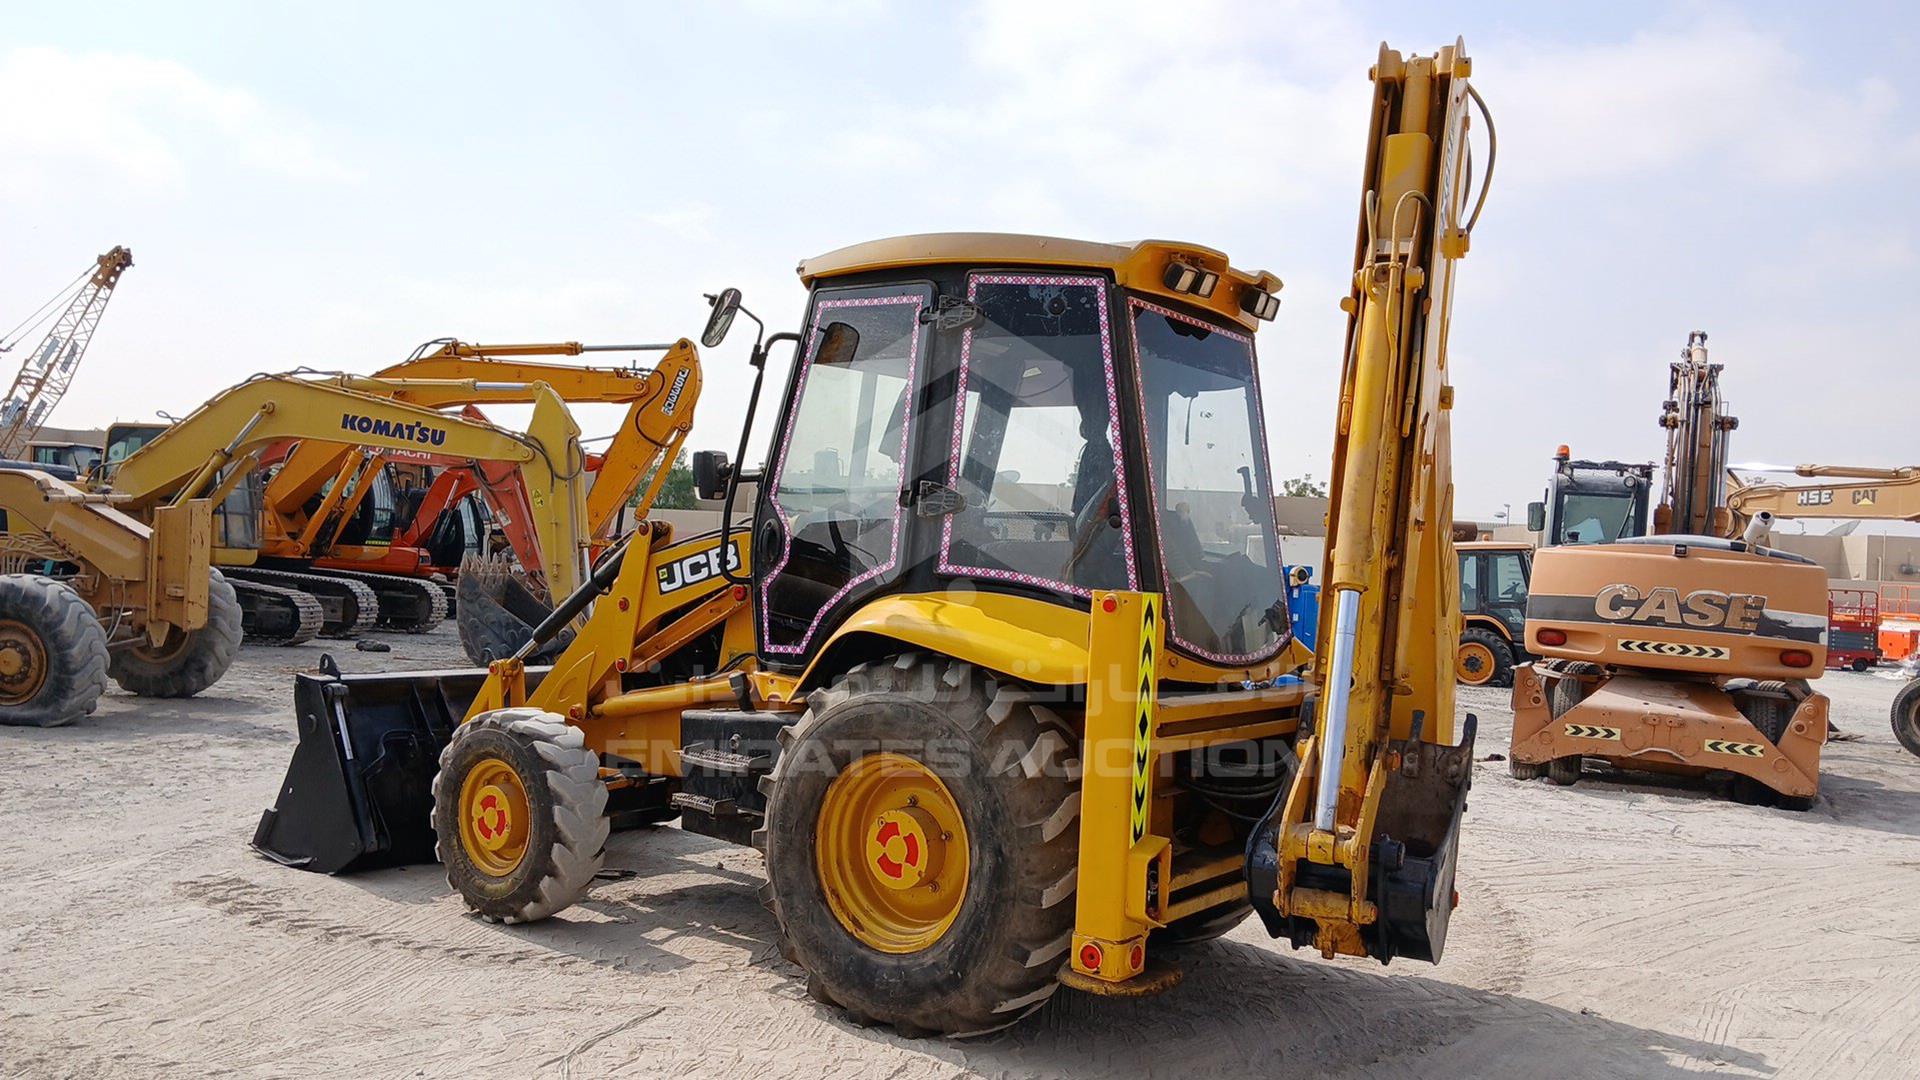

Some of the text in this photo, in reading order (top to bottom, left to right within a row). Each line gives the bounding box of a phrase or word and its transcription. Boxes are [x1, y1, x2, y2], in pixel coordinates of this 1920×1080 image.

[341, 413, 446, 446] KOMATSU
[1797, 489, 1834, 506] HSE
[1852, 489, 1878, 505] CAT
[660, 543, 738, 592] JCB
[1594, 583, 1768, 632] CASE
